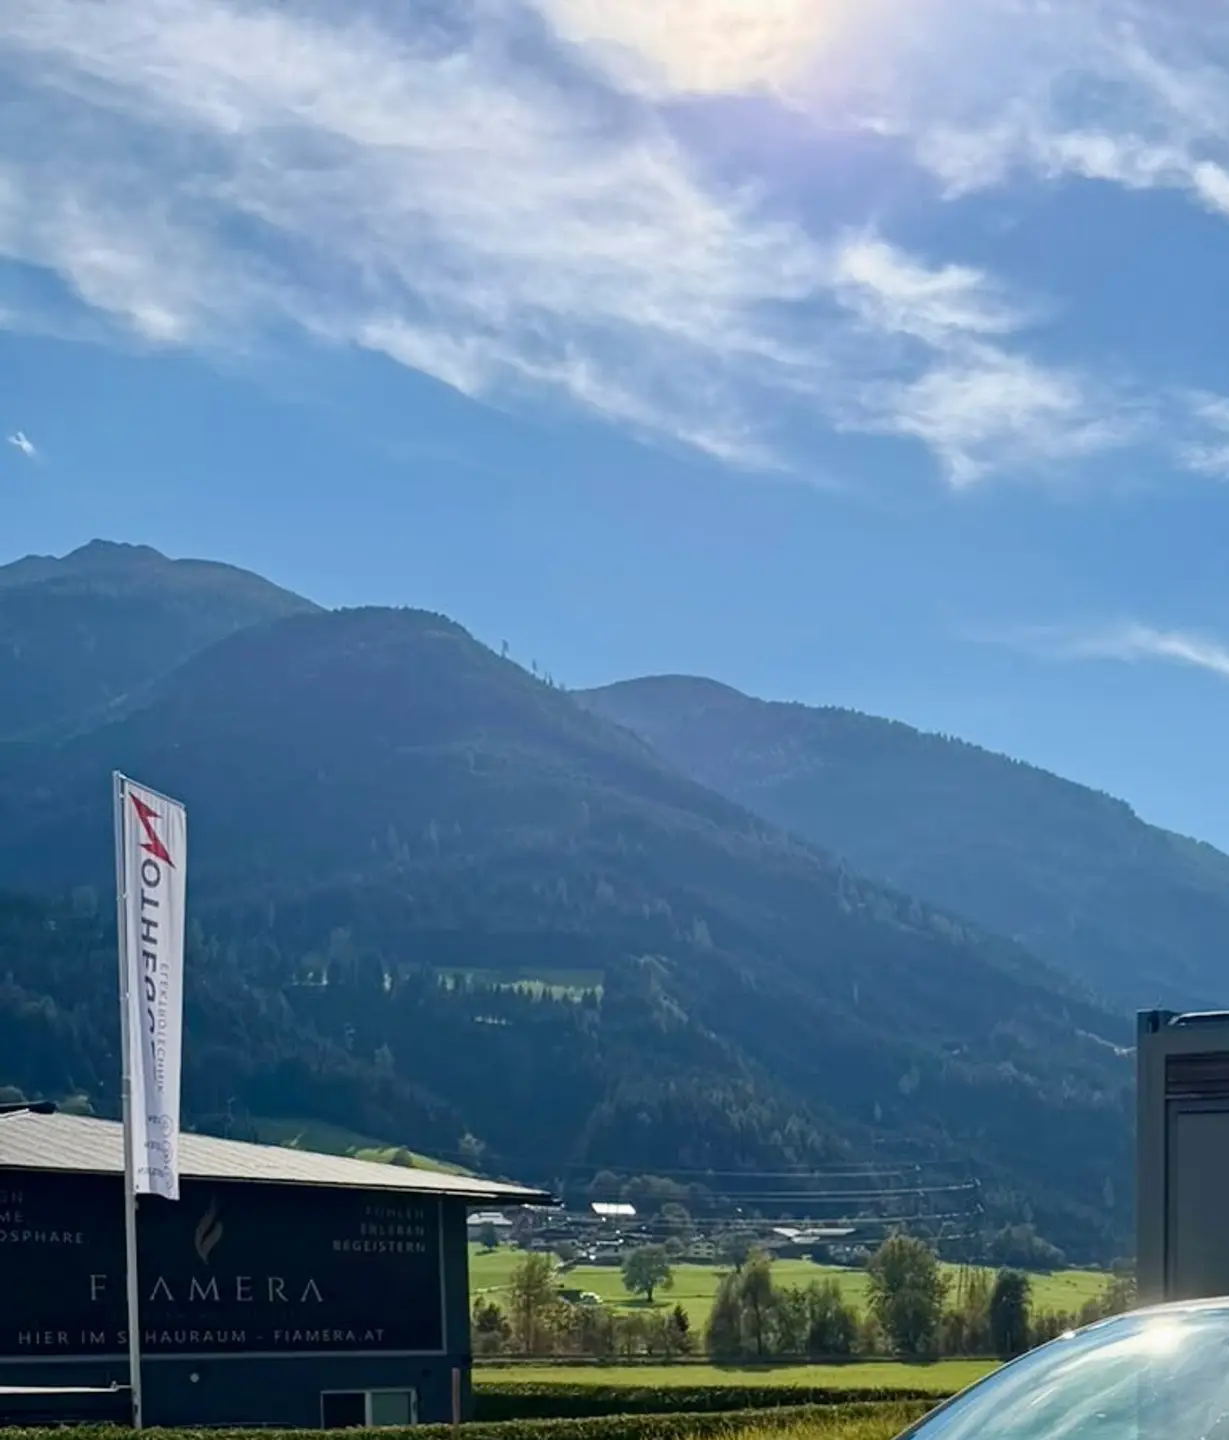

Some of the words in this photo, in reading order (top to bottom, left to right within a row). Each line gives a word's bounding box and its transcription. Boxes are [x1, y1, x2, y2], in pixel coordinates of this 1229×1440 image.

[89, 1274, 324, 1303] FAMERA
[18, 1330, 69, 1345] HIER
[81, 1330, 106, 1345] IM
[117, 1328, 247, 1345] SHAURAUM
[273, 1327, 386, 1343] FIAMERA.AT
